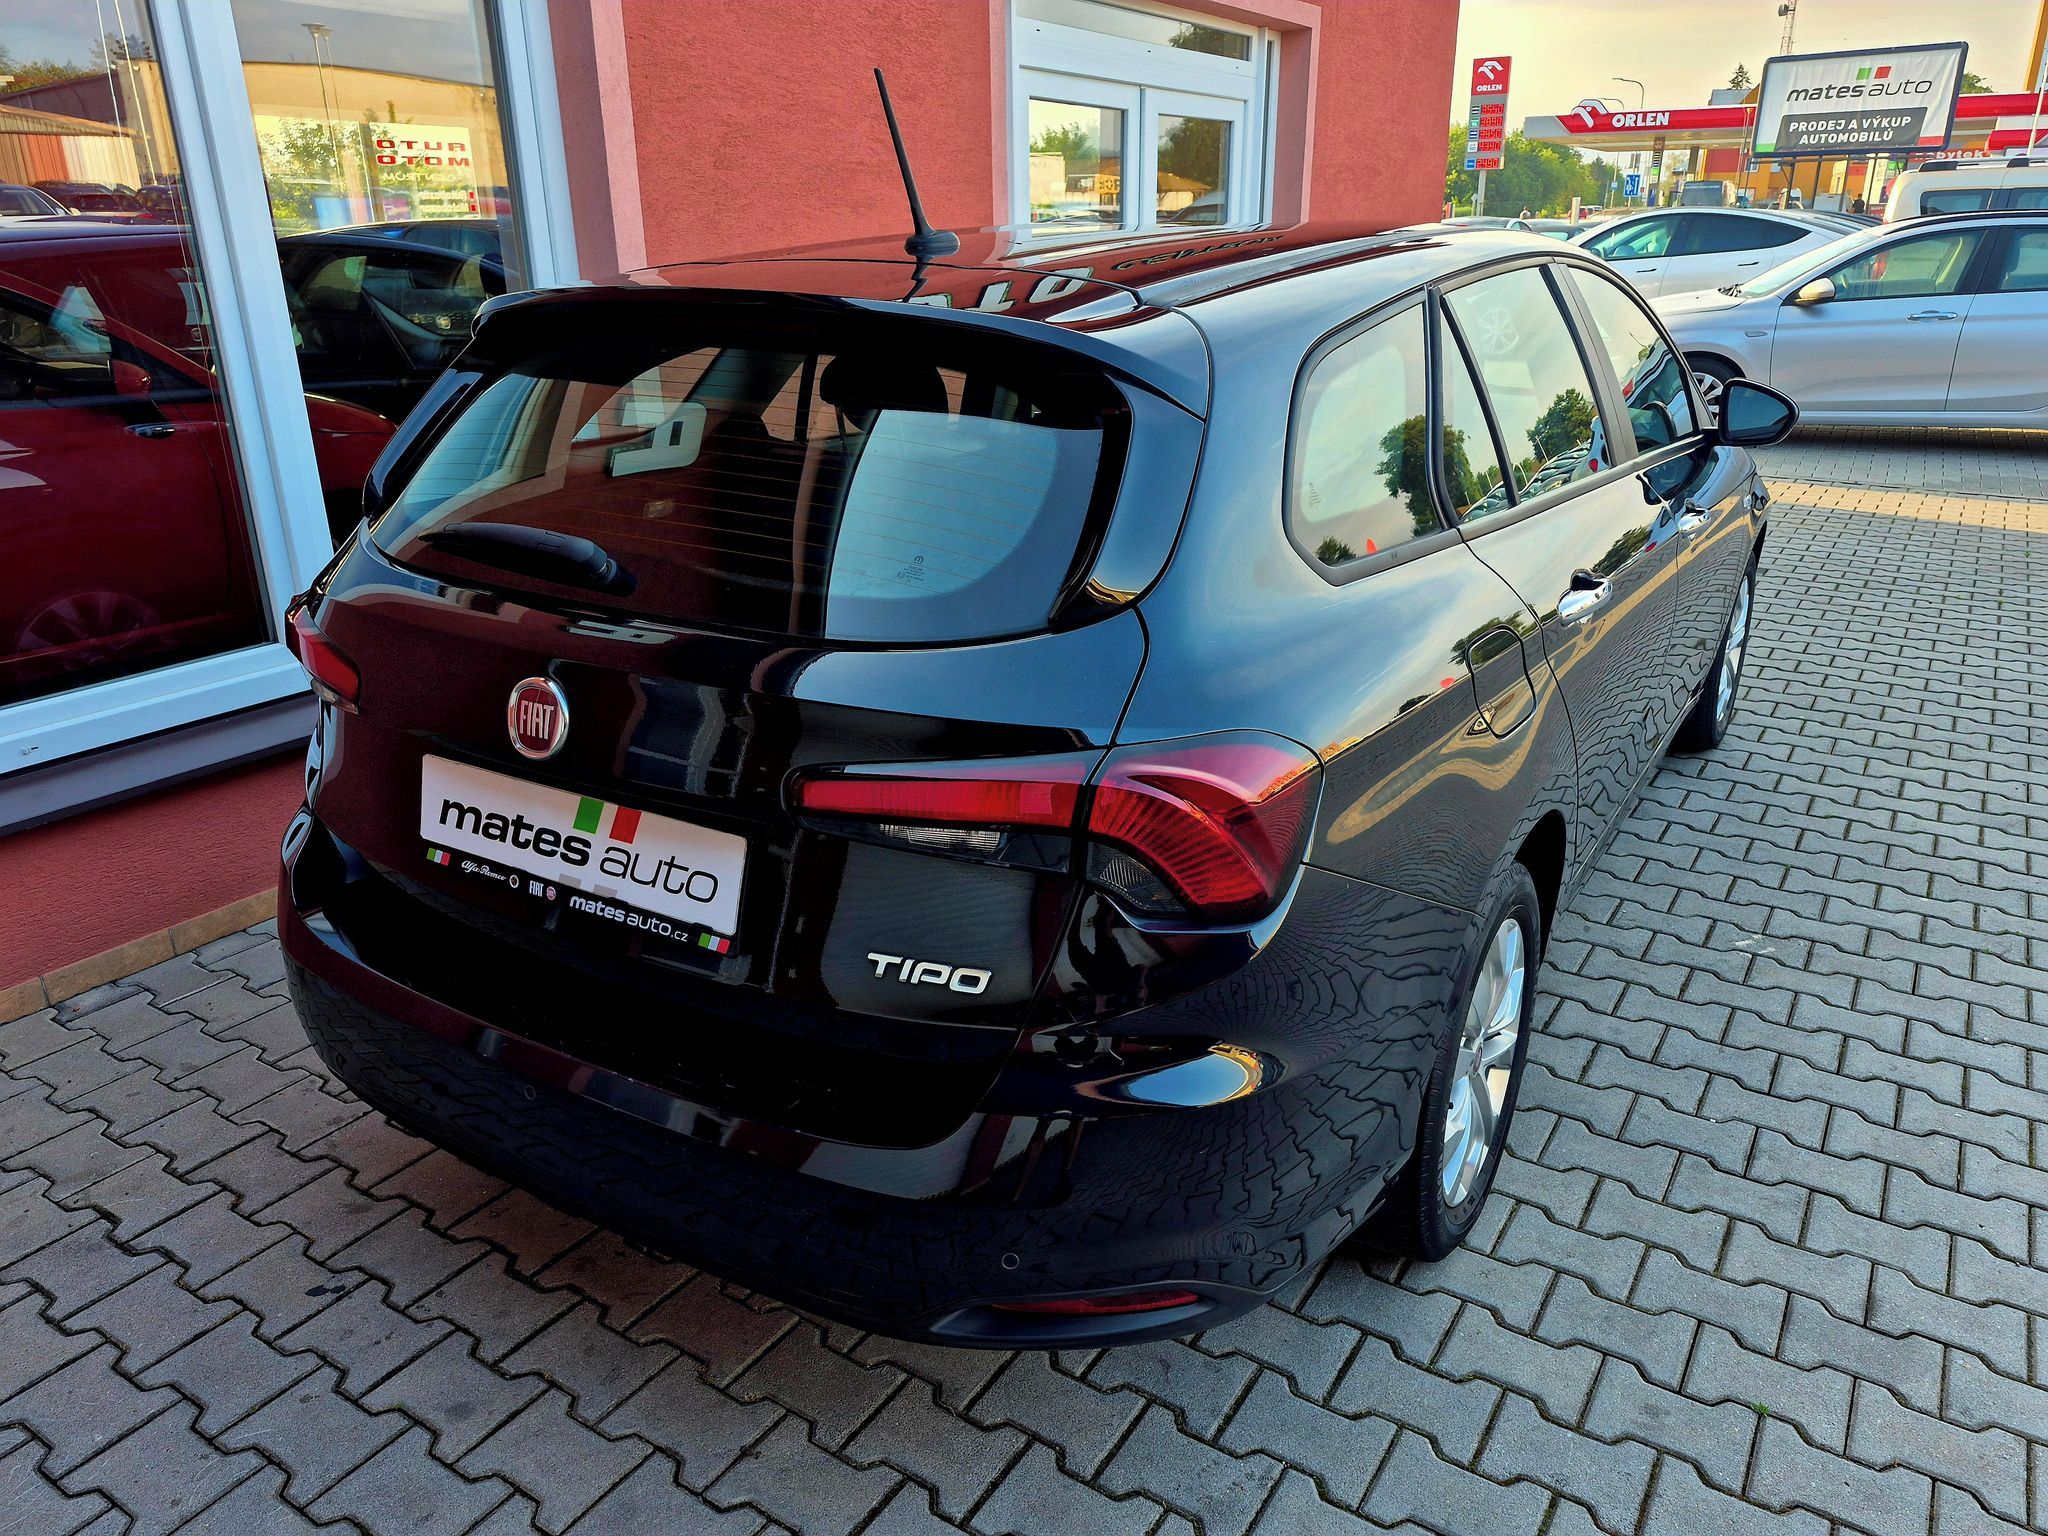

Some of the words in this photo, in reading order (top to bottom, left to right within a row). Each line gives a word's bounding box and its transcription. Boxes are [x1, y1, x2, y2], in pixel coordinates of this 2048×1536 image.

[1476, 84, 1503, 92] ORLEN
[1786, 84, 1866, 102] mates
[1868, 79, 1933, 97] auto
[1611, 112, 1670, 127] ORLEN
[1789, 120, 1846, 132] PRODEJ
[1848, 120, 1858, 130] A
[1862, 115, 1912, 129] VÝKUP
[520, 699, 555, 740] FIAT
[438, 797, 593, 867] mates
[599, 845, 719, 903] auto
[461, 860, 480, 873] Alfa
[480, 865, 507, 880] Romeo
[529, 880, 544, 897] FIAT
[867, 952, 992, 994] TIPO
